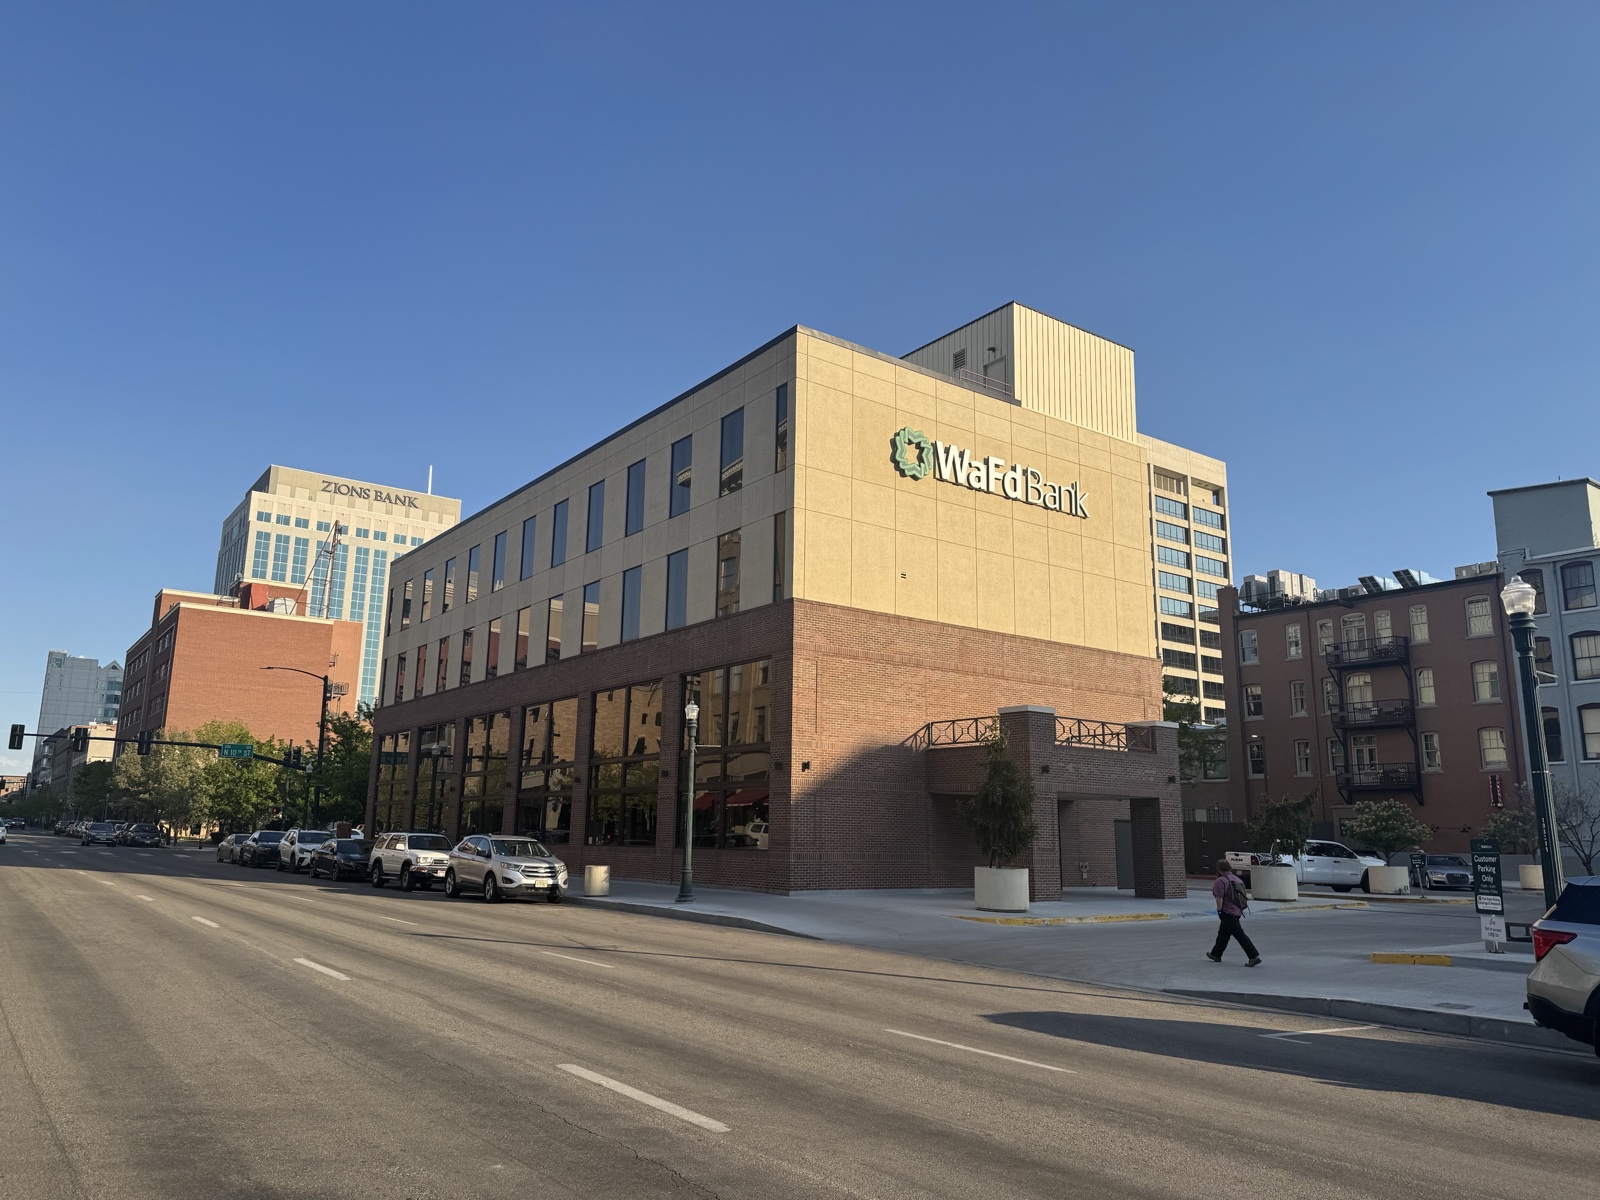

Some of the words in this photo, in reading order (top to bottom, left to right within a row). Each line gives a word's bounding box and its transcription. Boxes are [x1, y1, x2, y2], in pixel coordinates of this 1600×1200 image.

[934, 440, 1090, 519] WaFdBank
[321, 480, 370, 499] ZIONS
[374, 490, 419, 508] BANK
[1478, 864, 1496, 874] Parking
[1482, 875, 1494, 884] Only
